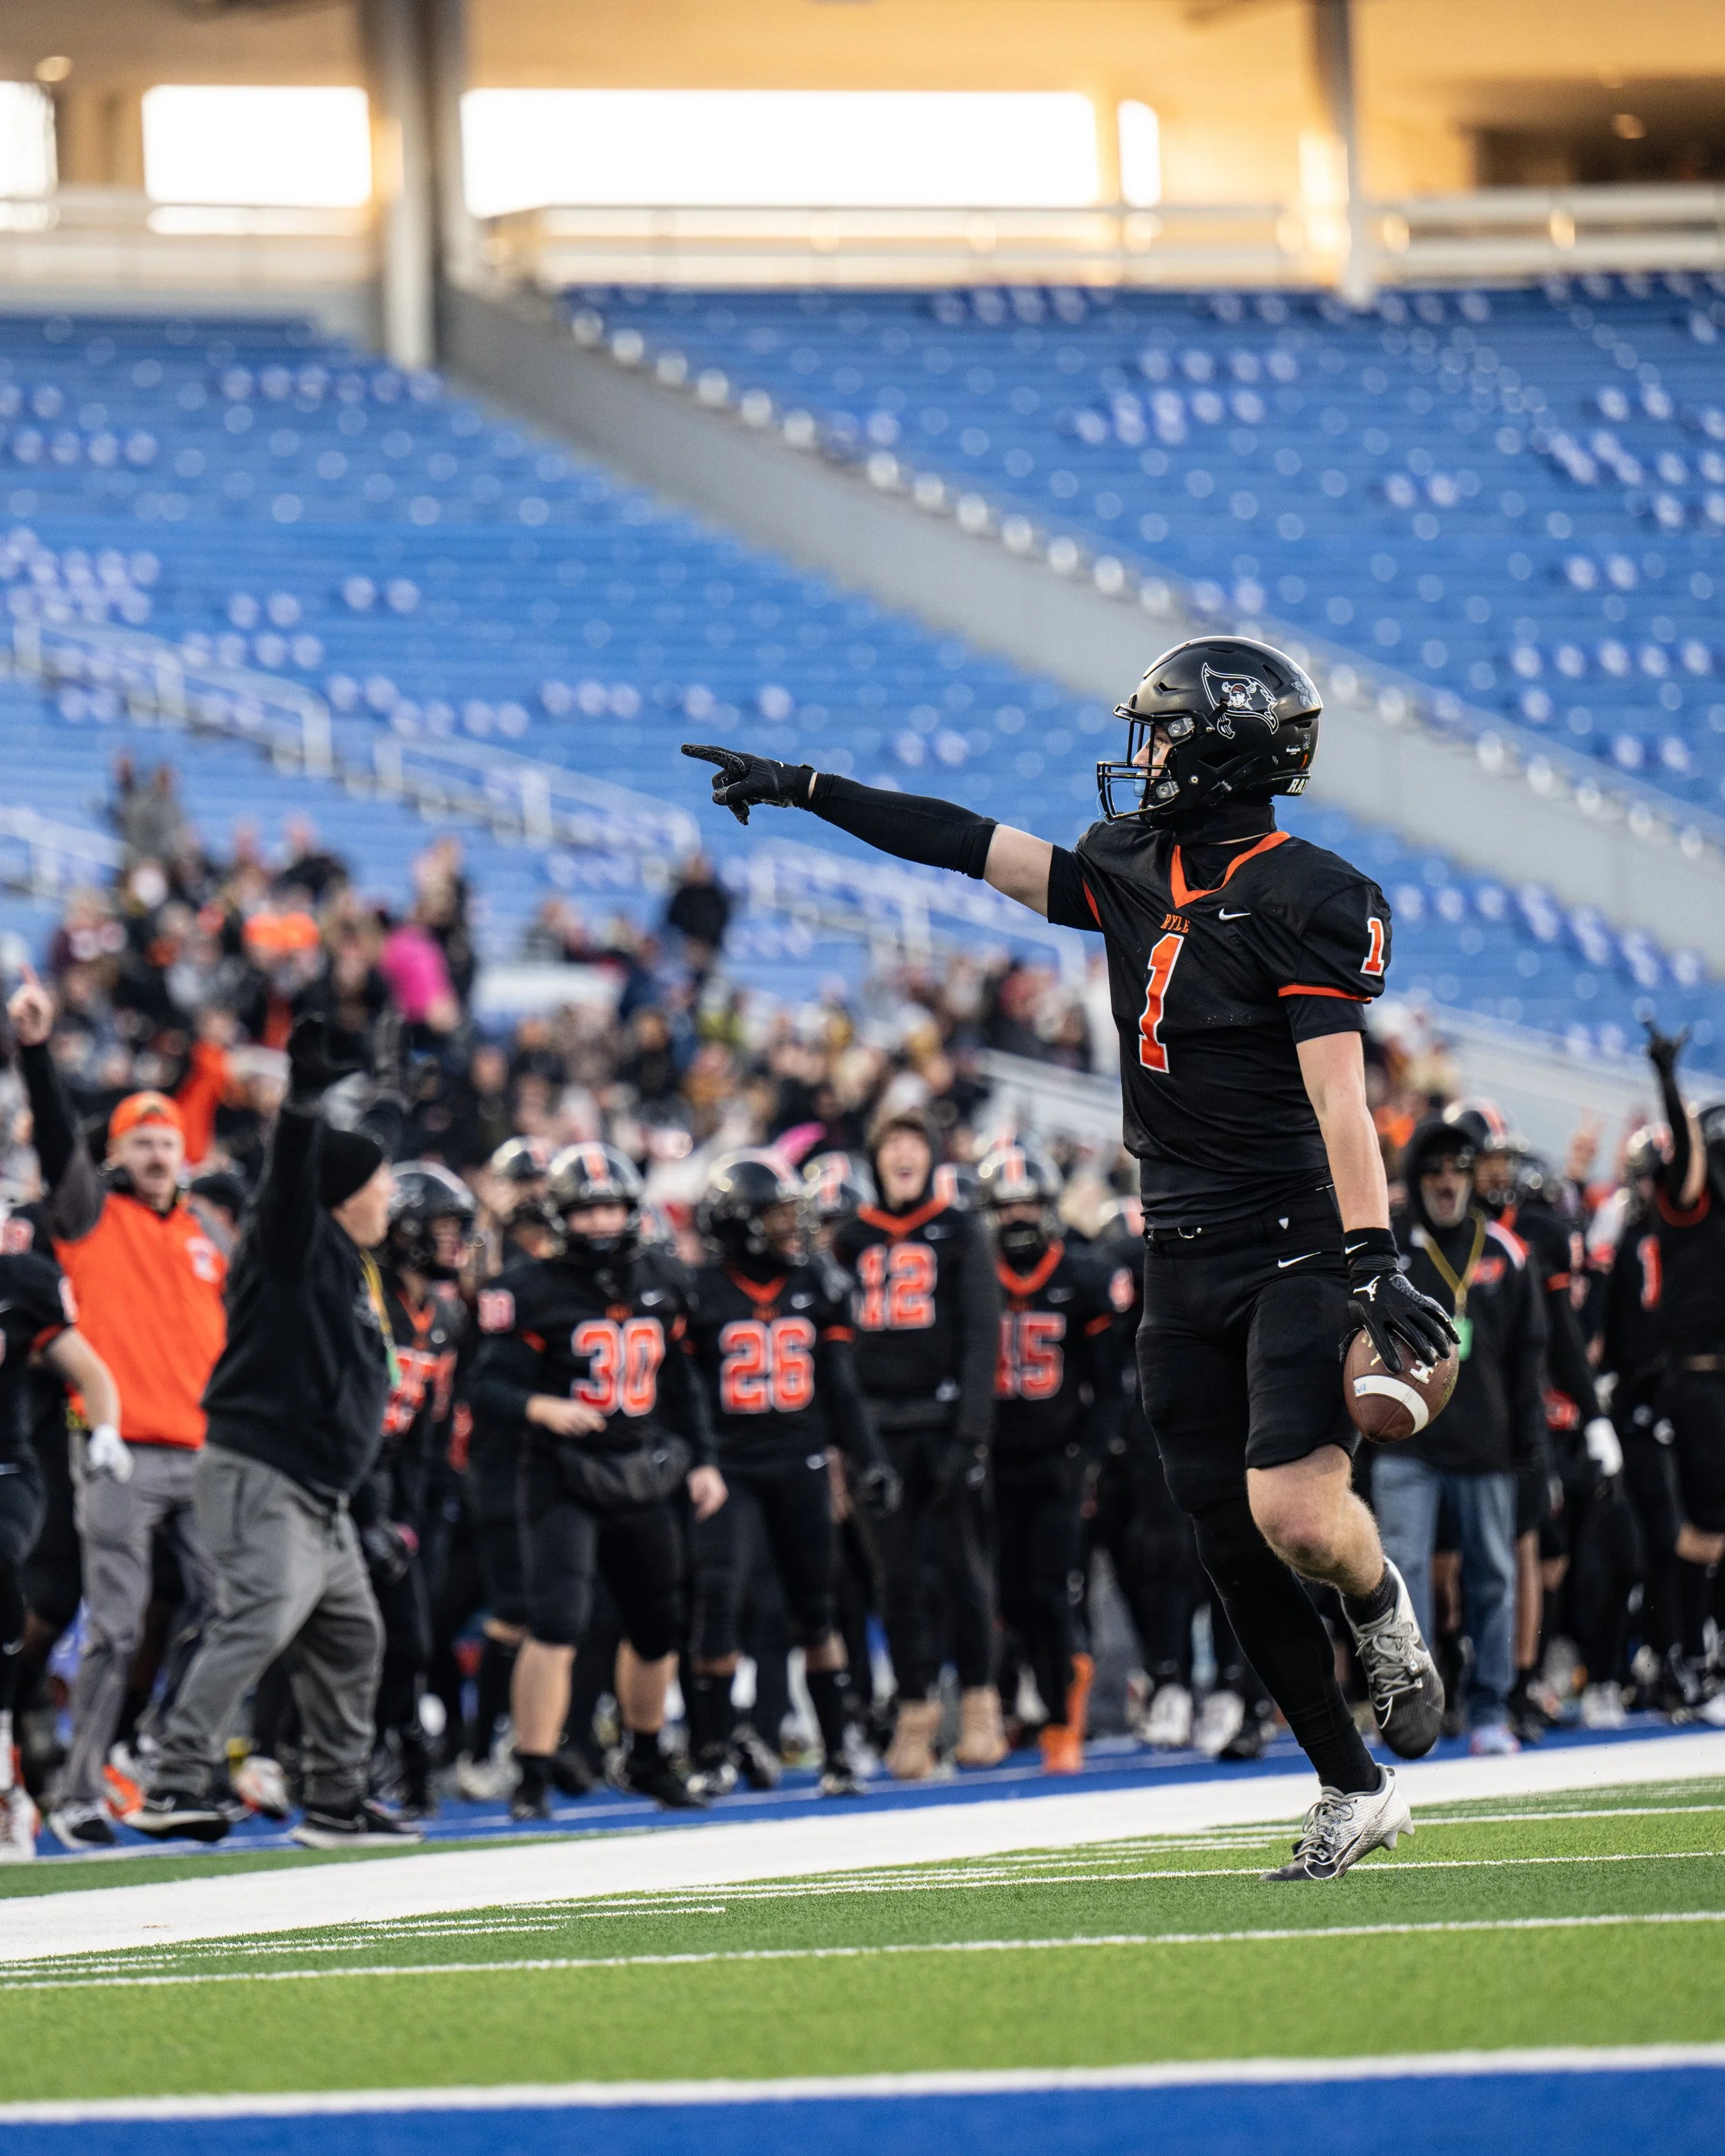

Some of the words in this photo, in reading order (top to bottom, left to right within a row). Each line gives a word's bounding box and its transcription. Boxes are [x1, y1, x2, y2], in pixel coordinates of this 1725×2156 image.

[1161, 914, 1190, 933] RYLE
[1360, 917, 1384, 976] 1
[1139, 933, 1185, 1074] 1
[855, 1244, 937, 1331] 12
[572, 1318, 664, 1416] 30
[720, 1317, 816, 1414] 26
